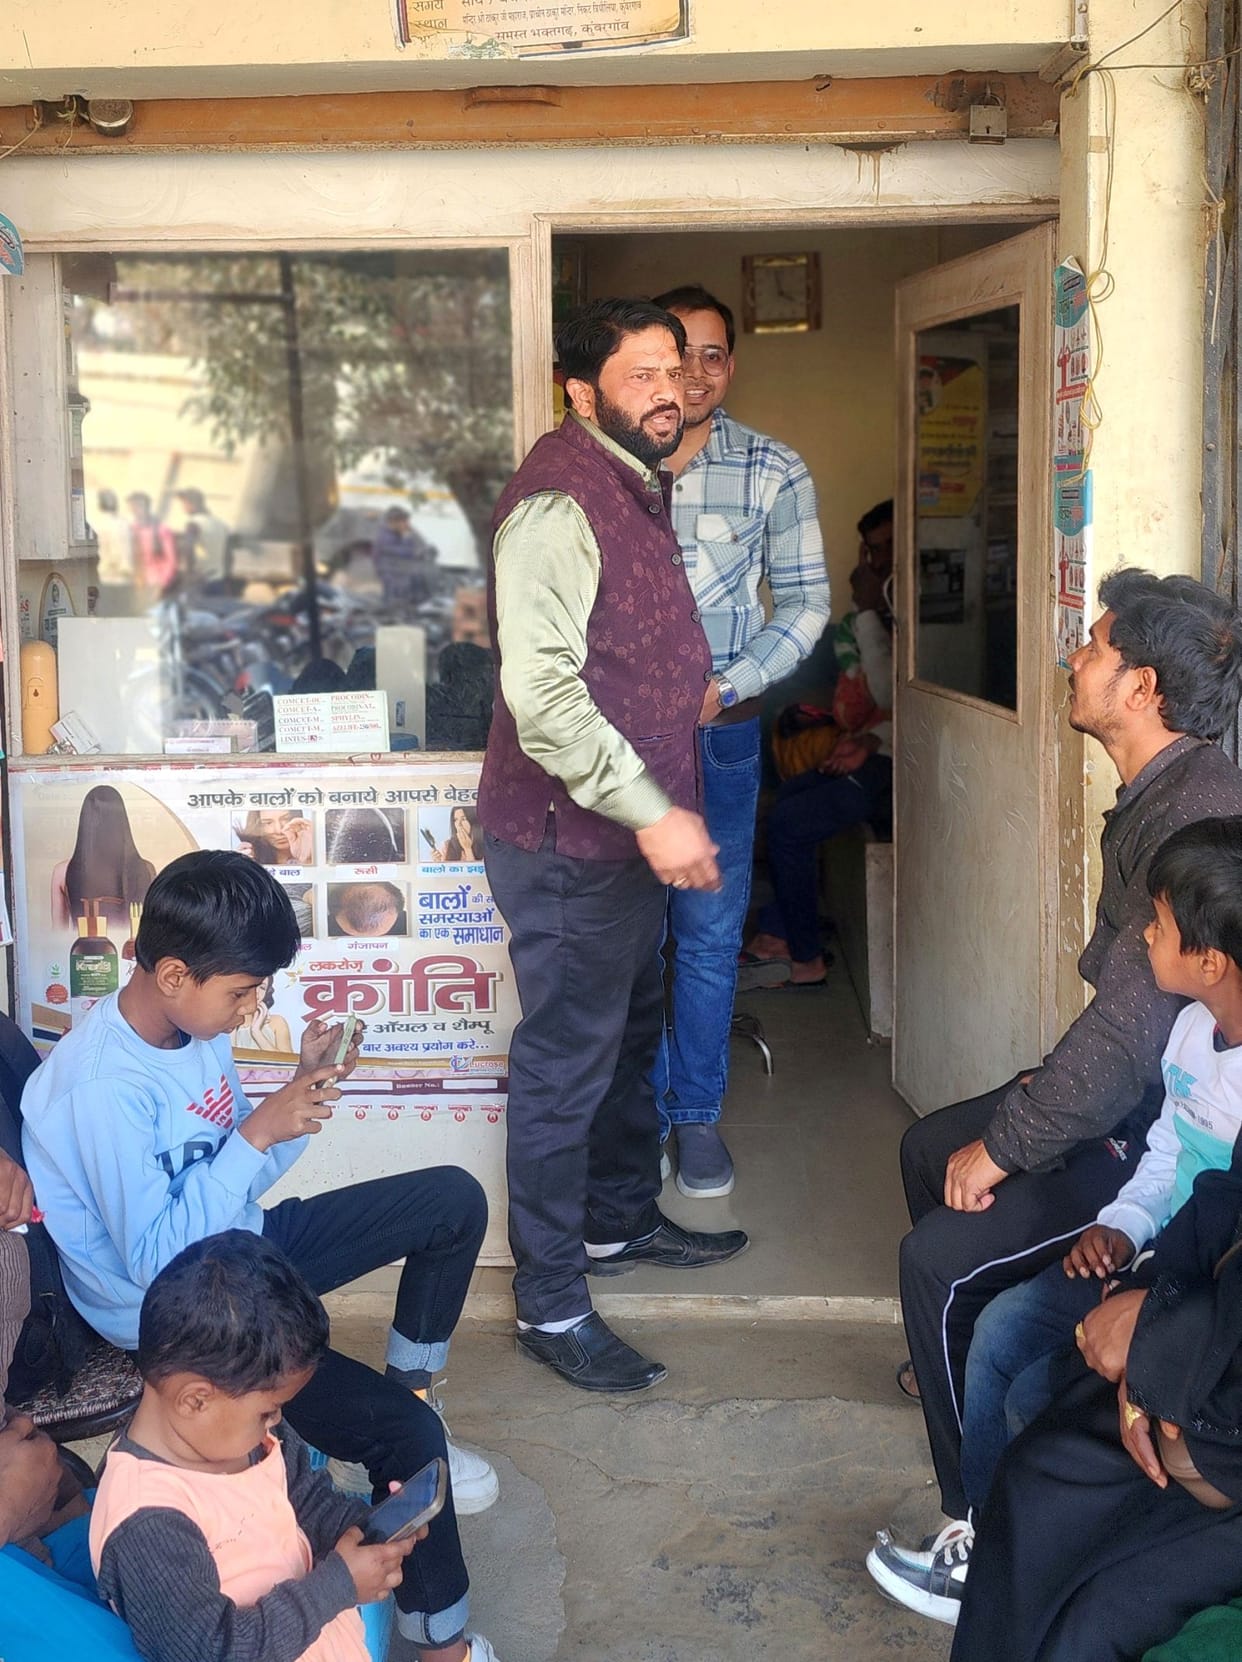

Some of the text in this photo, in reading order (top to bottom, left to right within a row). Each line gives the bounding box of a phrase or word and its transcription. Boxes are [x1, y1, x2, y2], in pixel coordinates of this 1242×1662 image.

[495, 30, 527, 40] समस्त
[187, 788, 244, 808] आपके
[249, 787, 296, 806] बालों
[297, 787, 324, 805] को
[328, 786, 377, 804] बनाये
[385, 784, 438, 803] आपसे
[418, 884, 472, 910] बालों
[472, 892, 484, 904] की
[418, 907, 495, 925] समस्याओं
[418, 926, 504, 945] का एक समाधान
[299, 954, 498, 1023] क्रांति
[372, 1020, 426, 1034] ऑयल
[432, 1022, 446, 1032] व
[451, 1017, 496, 1035] शैम्पू
[362, 1043, 381, 1052] बार
[421, 1040, 454, 1053] प्रयोग
